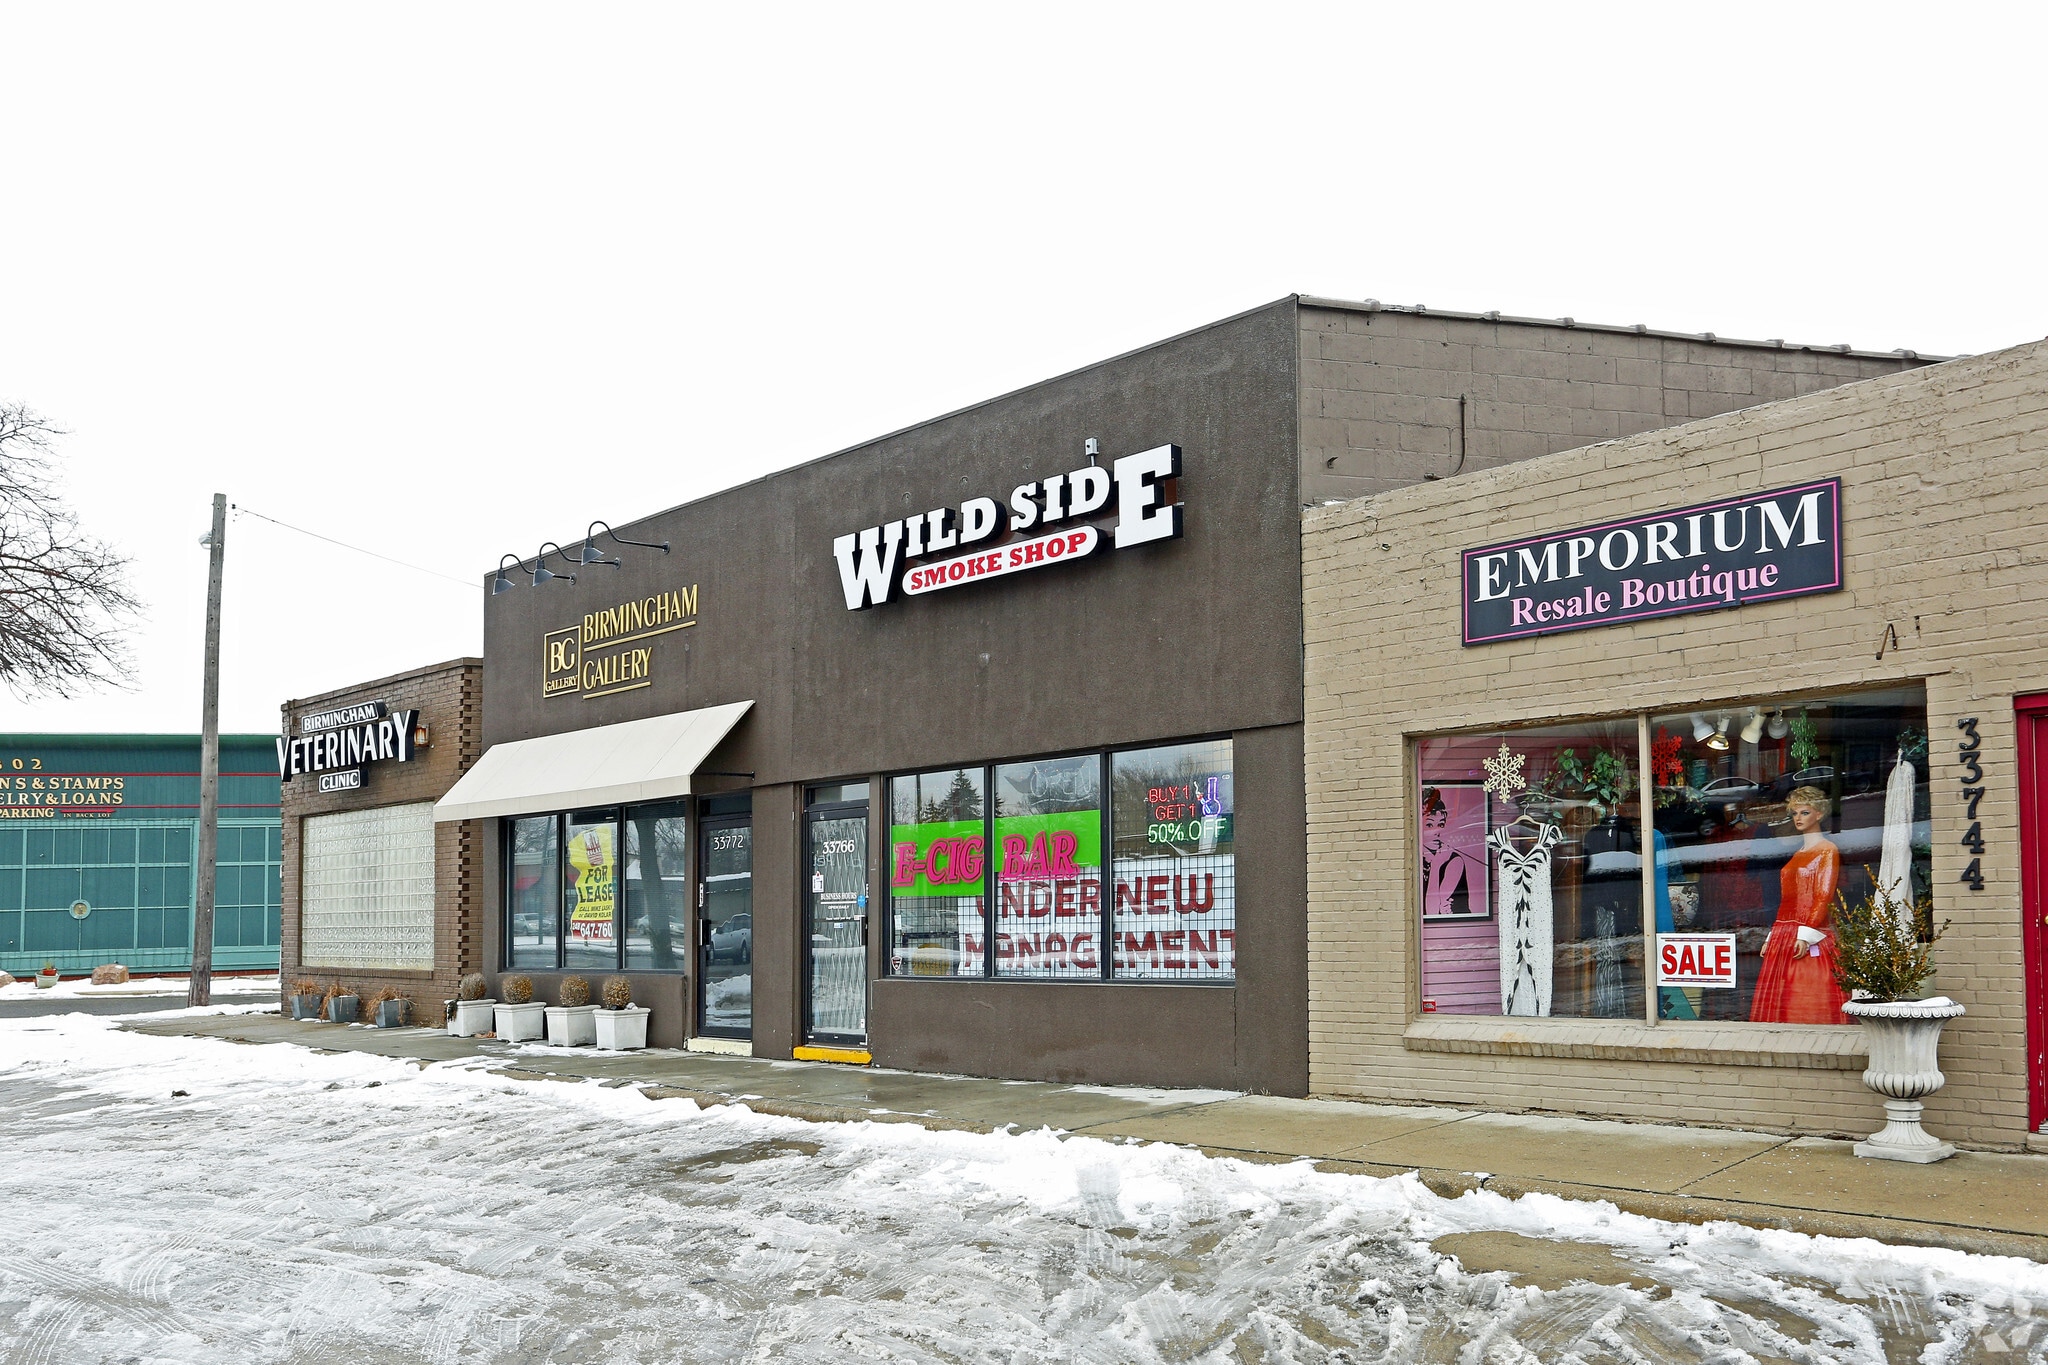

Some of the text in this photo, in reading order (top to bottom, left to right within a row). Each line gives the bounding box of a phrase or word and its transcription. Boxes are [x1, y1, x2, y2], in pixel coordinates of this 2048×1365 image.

[833, 443, 1174, 610] WILD SIDE
[911, 531, 1088, 590] SMOKE SHOP
[1473, 491, 1826, 603] EMPORIUM
[1510, 563, 1780, 627] Resale Boutique
[583, 583, 698, 644] BIRMINGHAM
[582, 646, 652, 690] GALLERY
[545, 674, 579, 692] GALLERY
[303, 704, 376, 731] BIRMINGHAM
[275, 709, 412, 781] VETERINARY
[0, 758, 43, 770] 02
[31, 777, 46, 790] &
[49, 777, 124, 790] STAMPS
[321, 772, 359, 790] CLINIC
[1148, 784, 1189, 803] BUY 1
[61, 792, 123, 805] LOANS
[1155, 803, 1195, 821] GET 1
[1957, 717, 1986, 891] 33744
[713, 834, 744, 850] 33772
[1148, 817, 1227, 844] 50% OFF
[822, 839, 855, 854] 33766
[892, 830, 1080, 887] E-CIG BAR
[585, 866, 608, 884] FOR
[578, 883, 613, 903] LEASE
[1113, 873, 1214, 916] NEW
[1661, 944, 1732, 975] SALE
